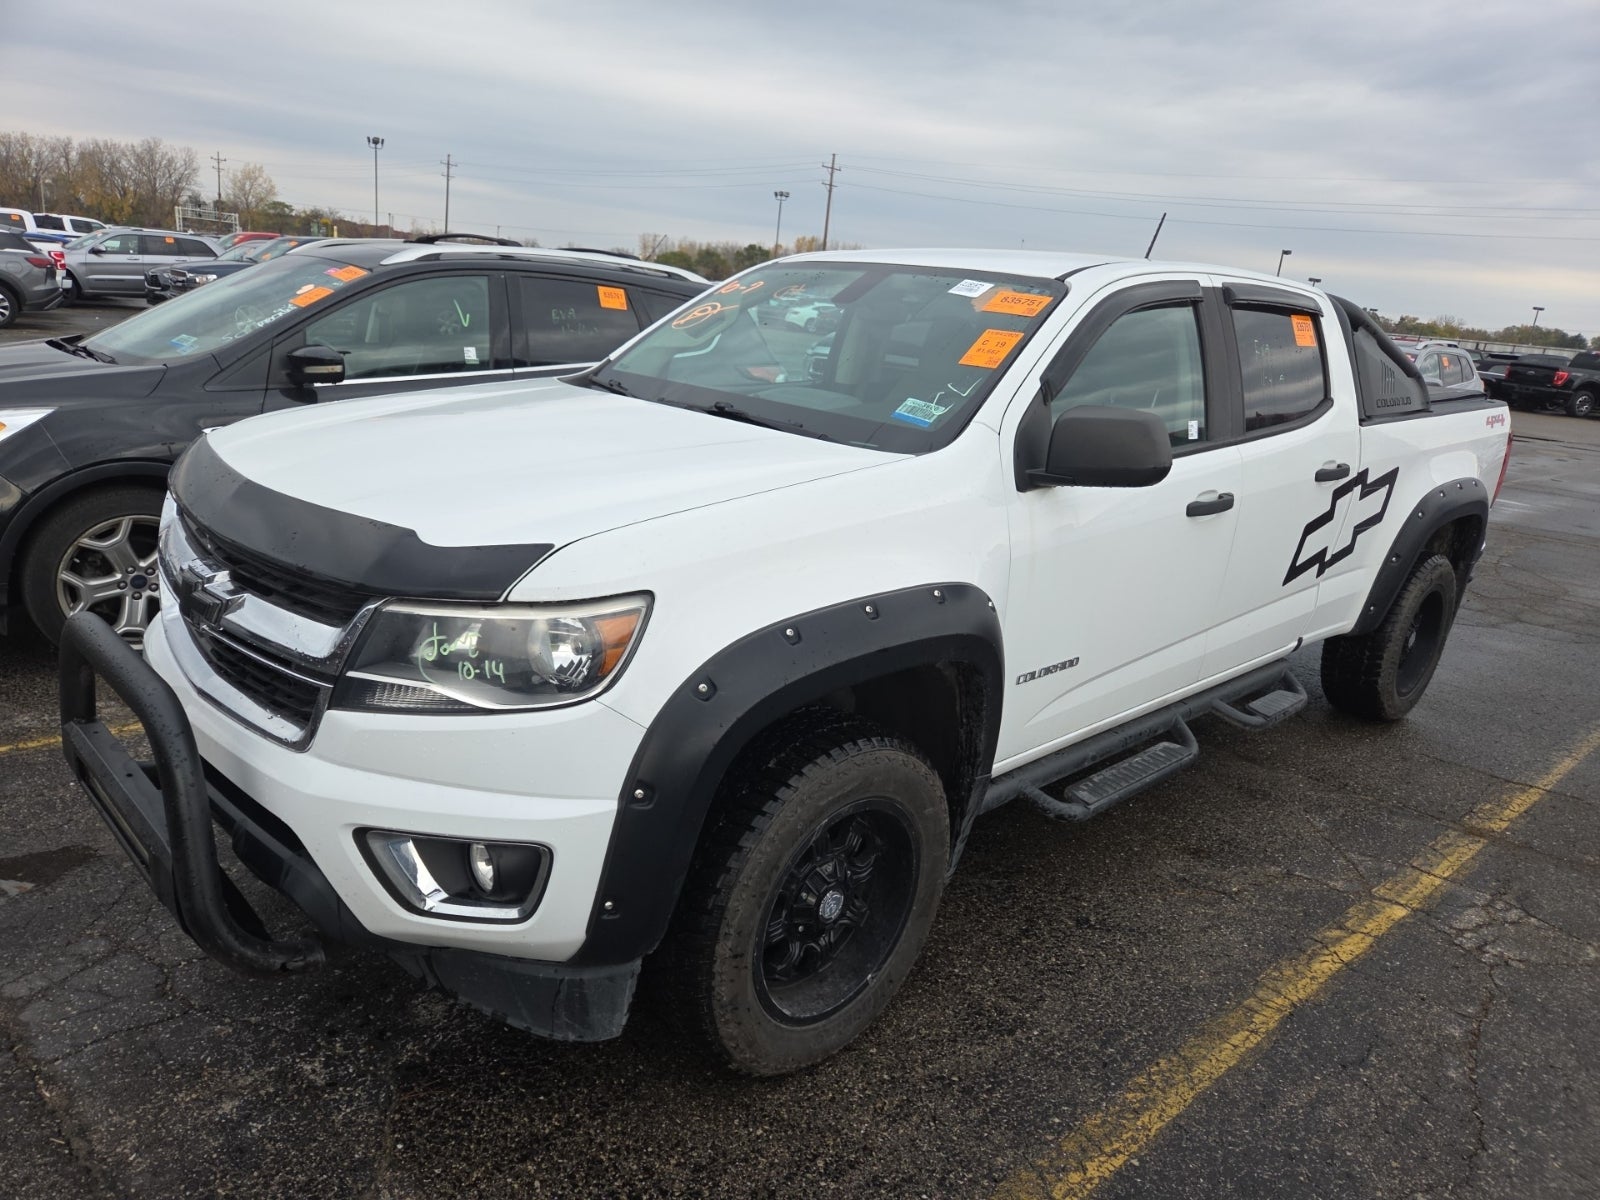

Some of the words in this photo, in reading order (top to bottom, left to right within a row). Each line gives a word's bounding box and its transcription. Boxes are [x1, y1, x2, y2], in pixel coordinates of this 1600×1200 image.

[1000, 296, 1044, 308] 835751
[458, 660, 506, 684] 10-14
[1015, 656, 1080, 686] COLORADO
